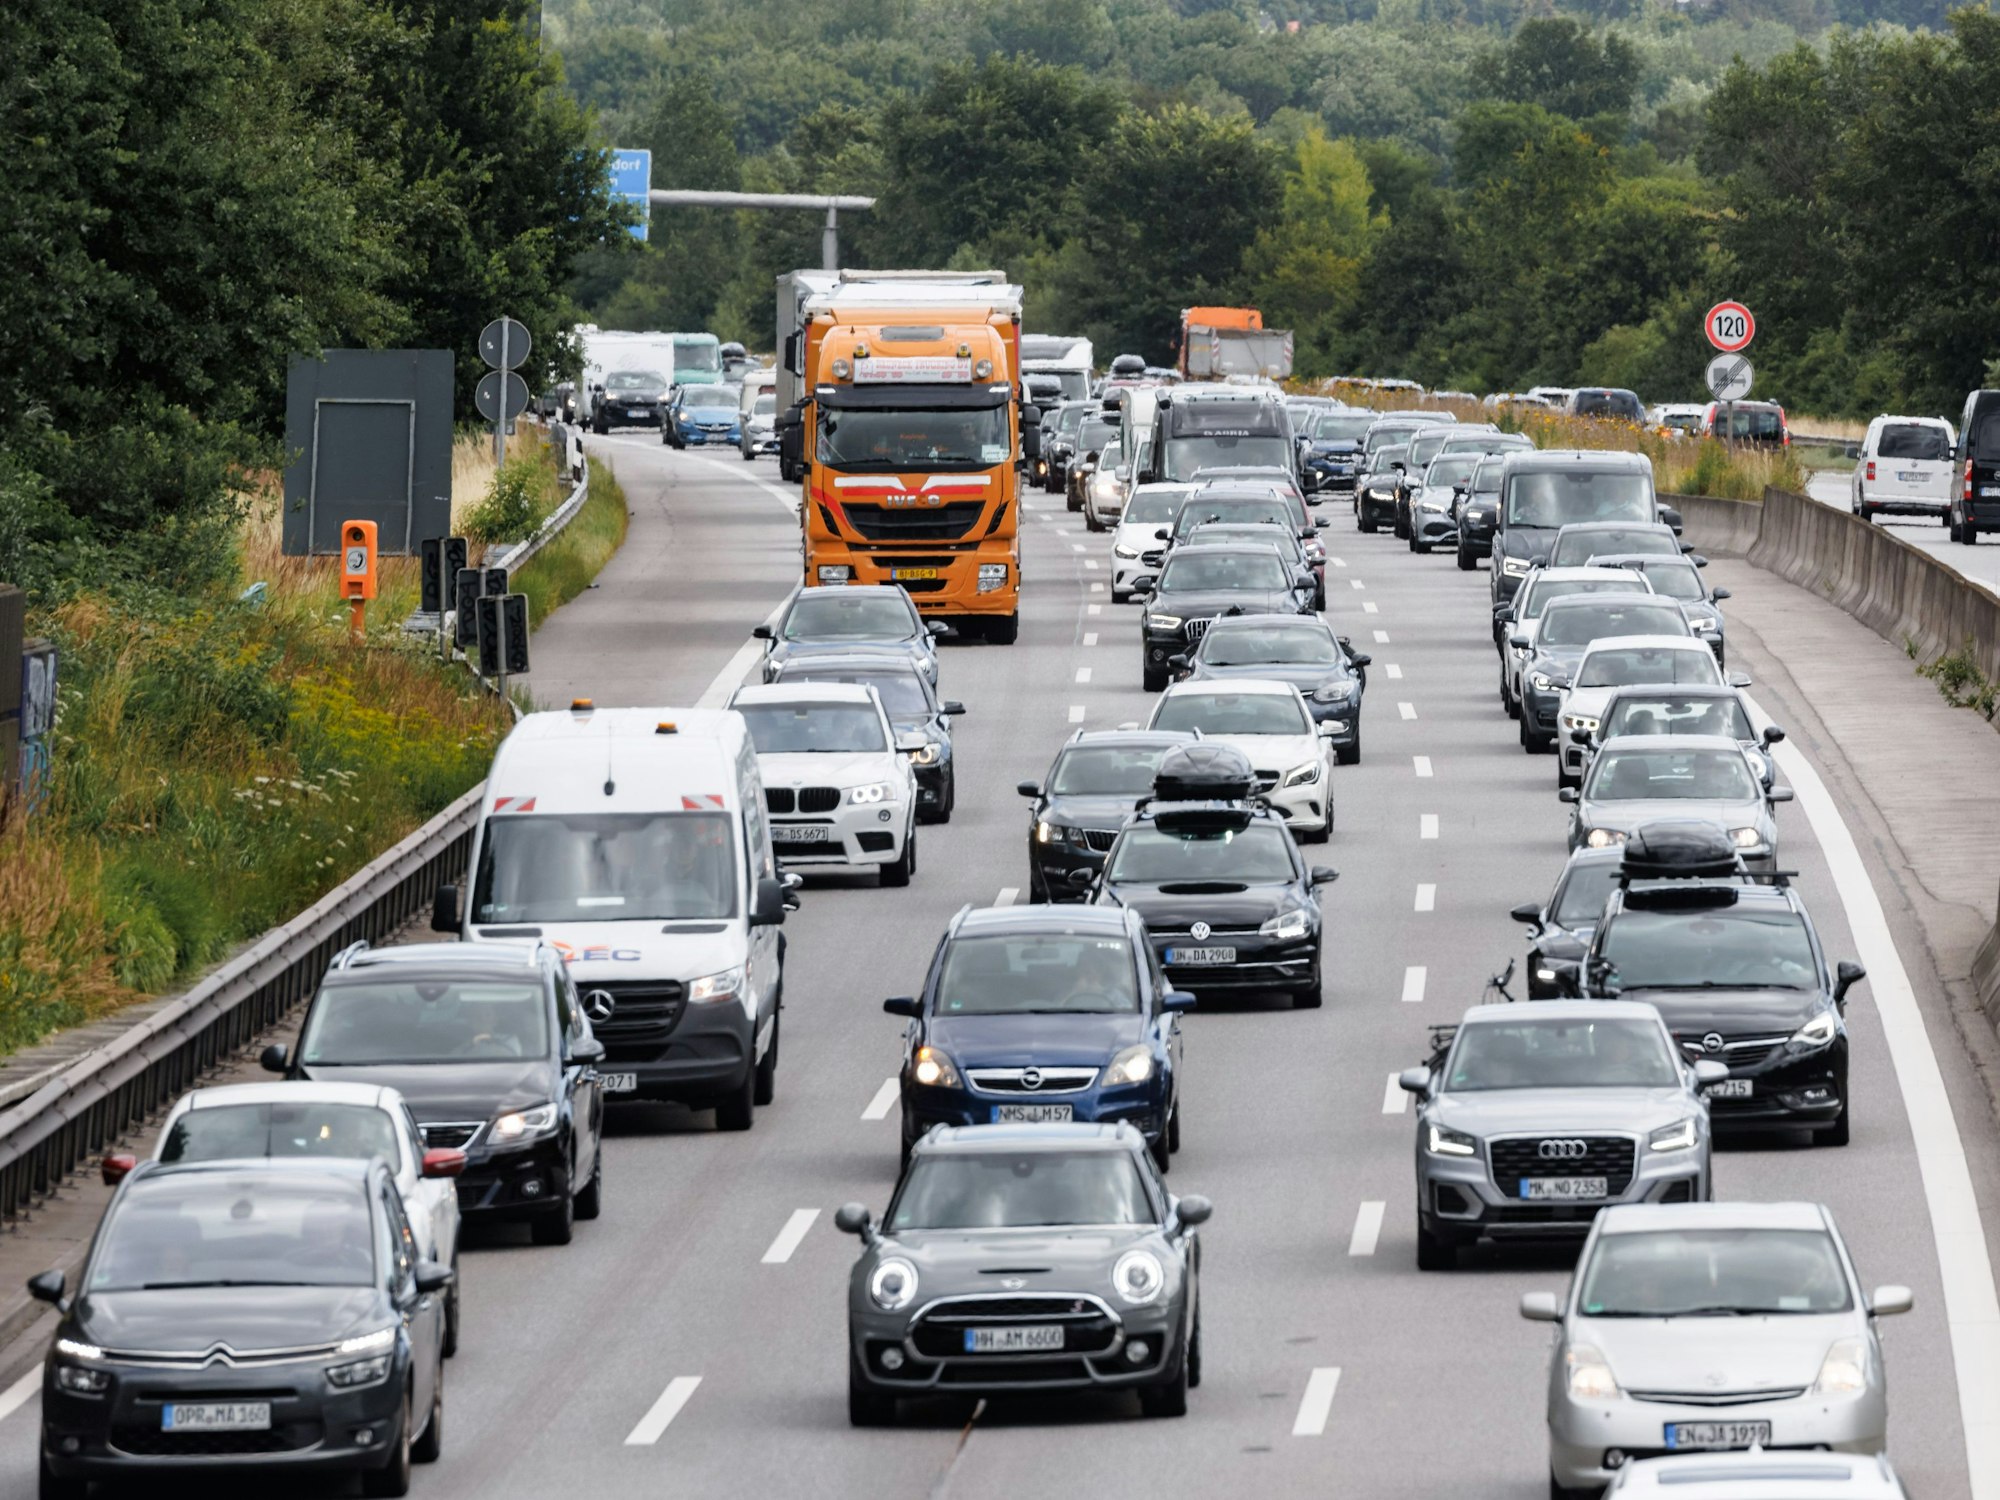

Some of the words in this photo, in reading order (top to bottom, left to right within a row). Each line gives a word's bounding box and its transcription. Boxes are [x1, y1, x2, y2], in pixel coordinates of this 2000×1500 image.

[611, 159, 640, 170] dorf
[1716, 316, 1744, 337] 120
[1193, 949, 1206, 961] DA
[597, 1075, 632, 1088] 2071
[1000, 1106, 1025, 1121] NMS
[1054, 1106, 1071, 1120] 57
